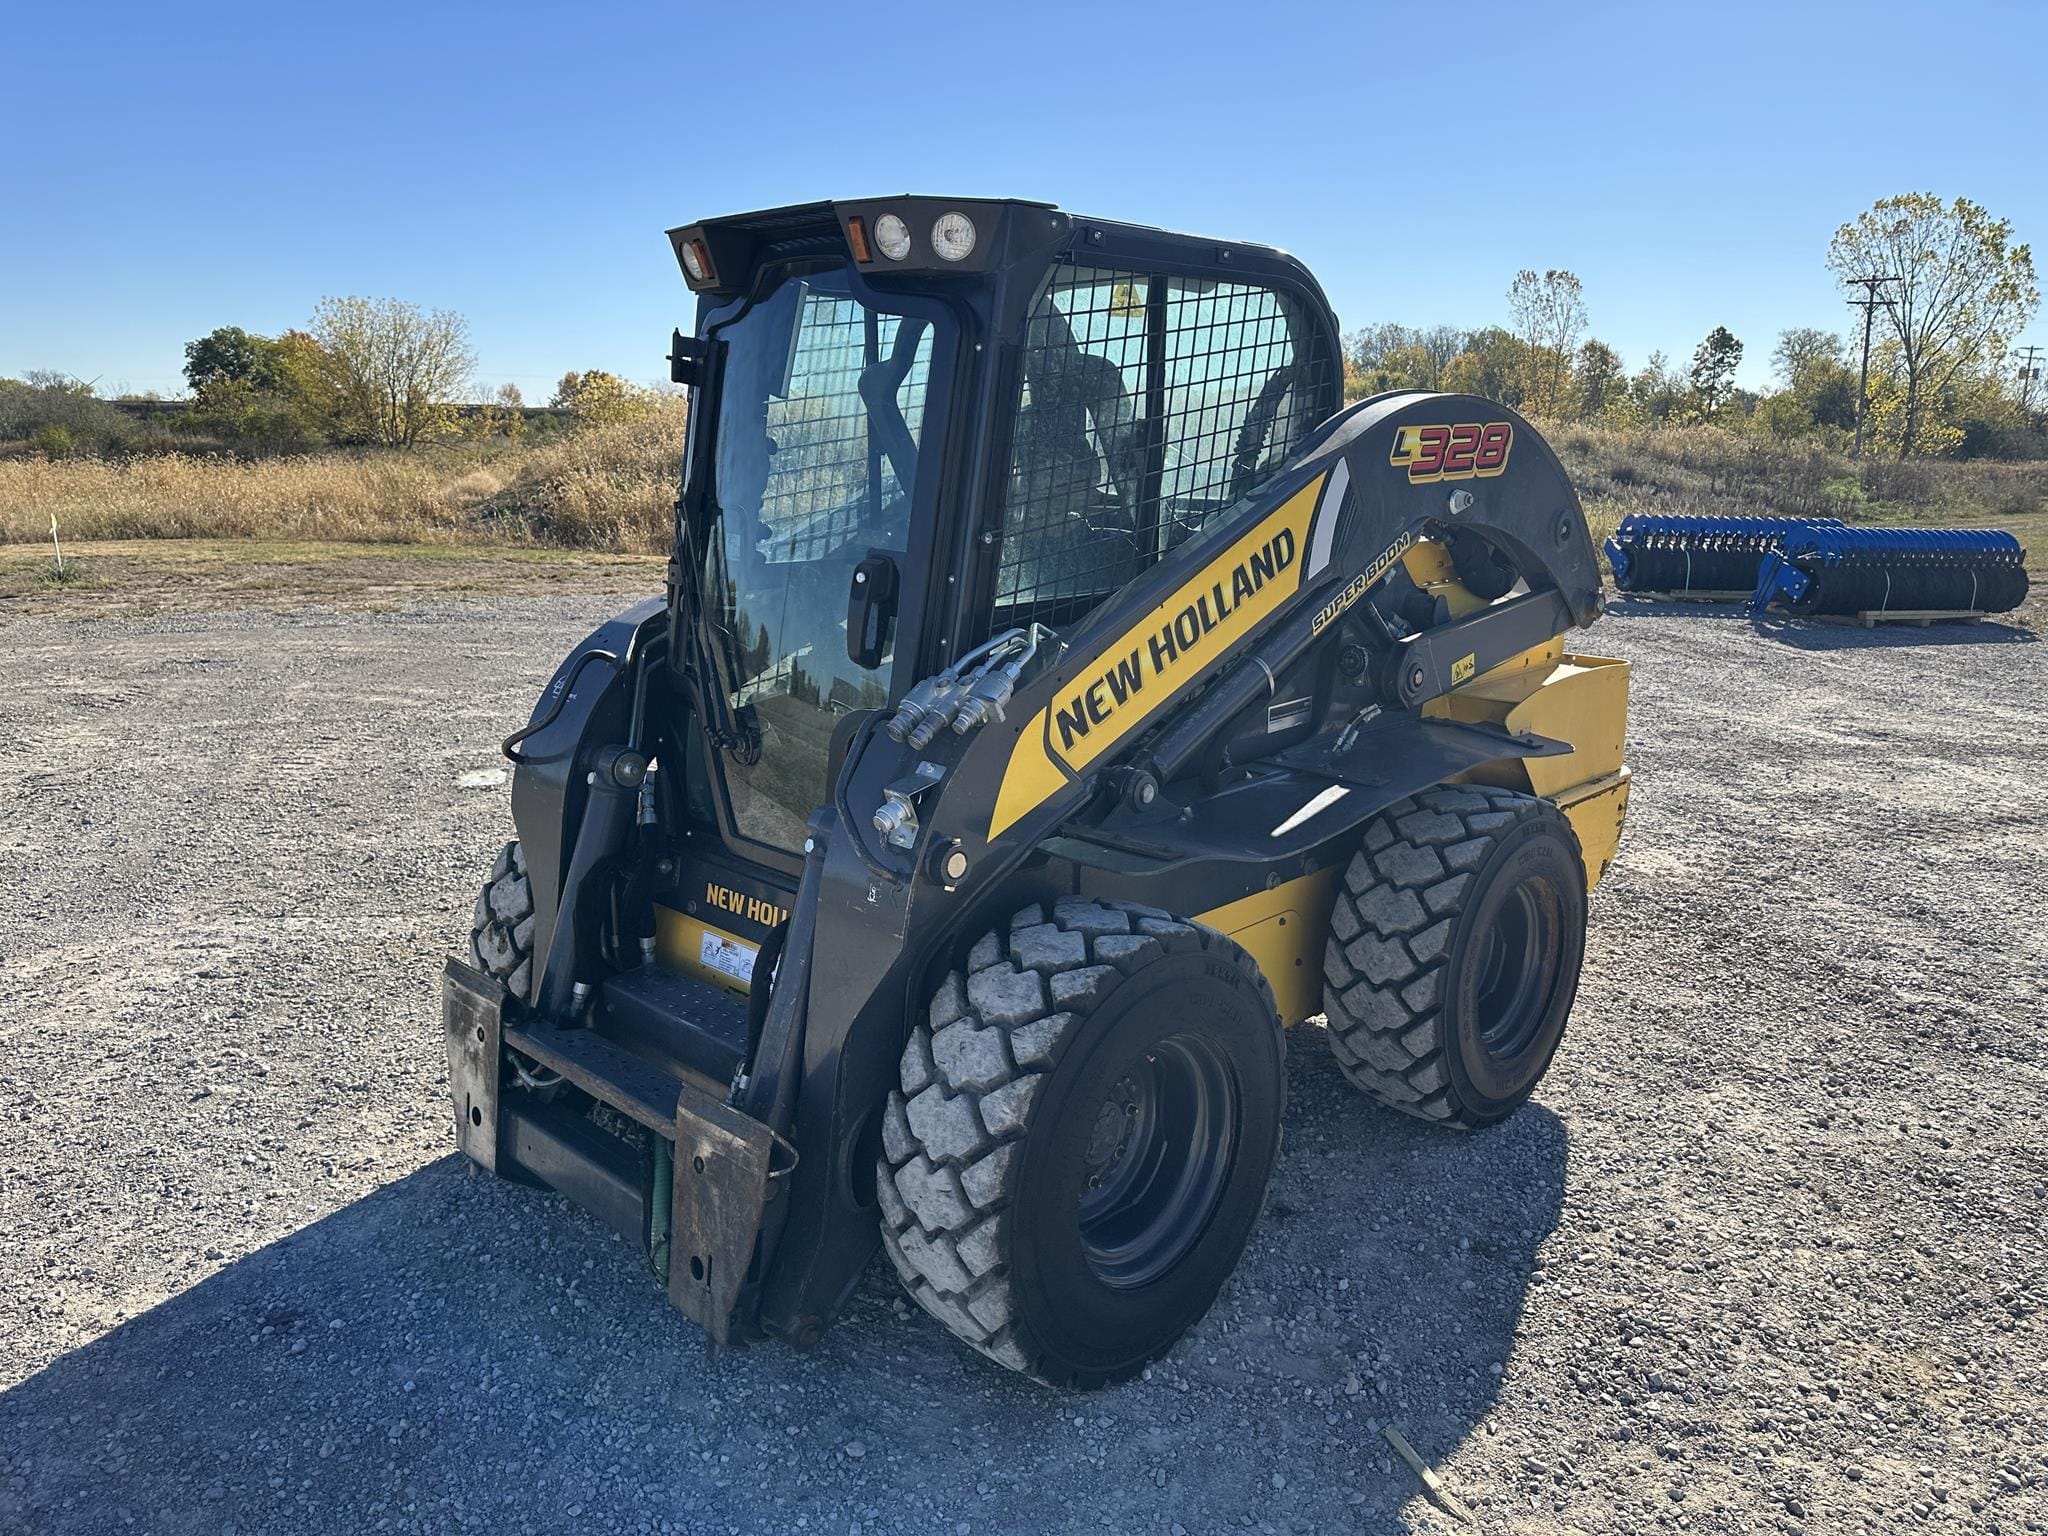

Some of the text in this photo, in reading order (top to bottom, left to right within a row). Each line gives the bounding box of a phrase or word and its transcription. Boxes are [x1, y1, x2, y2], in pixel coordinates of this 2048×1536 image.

[1390, 422, 1514, 484] L328
[1312, 531, 1411, 636] SUPER BOOM
[1056, 527, 1295, 751] NEW HOLLAND
[706, 882, 745, 915] NEW
